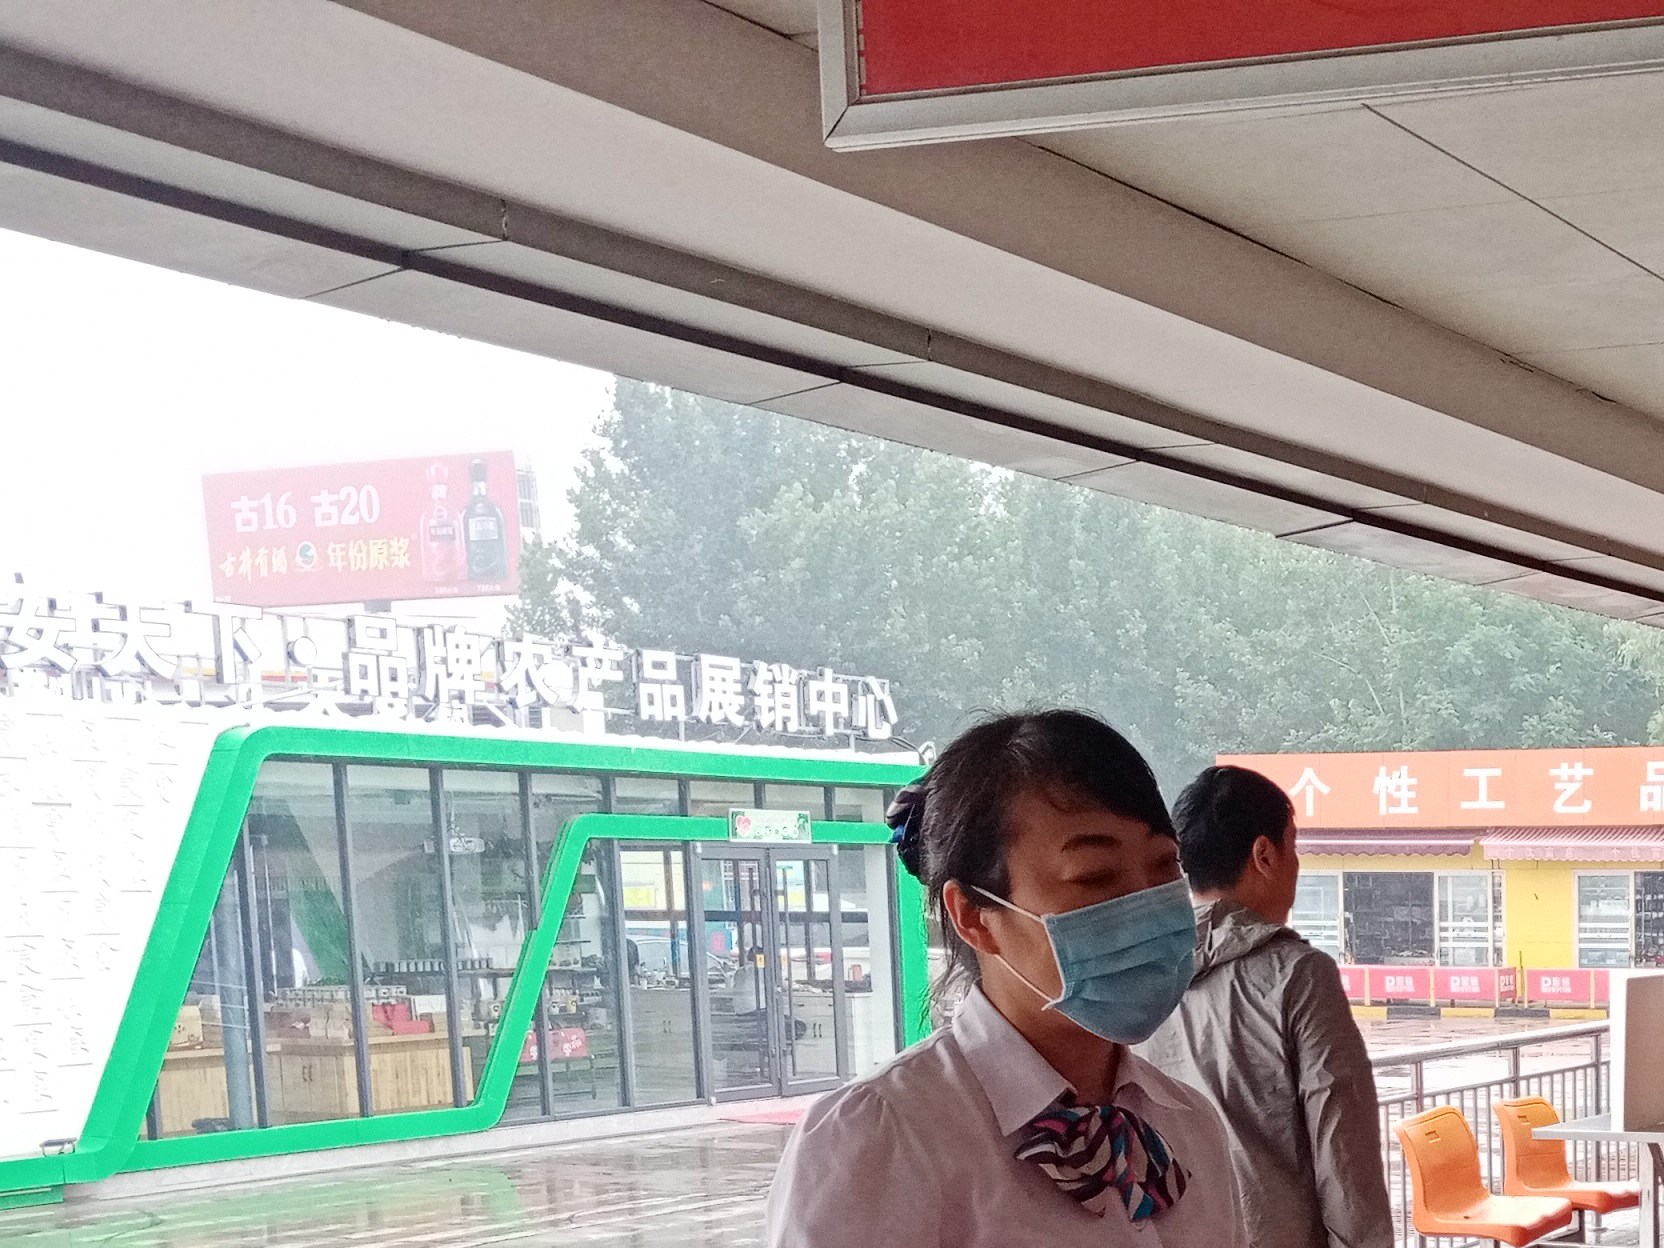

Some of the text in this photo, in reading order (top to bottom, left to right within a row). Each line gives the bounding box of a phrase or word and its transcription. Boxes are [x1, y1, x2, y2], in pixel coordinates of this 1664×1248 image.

[231, 484, 380, 532] 古16 古20
[327, 536, 412, 571] 年份原浆
